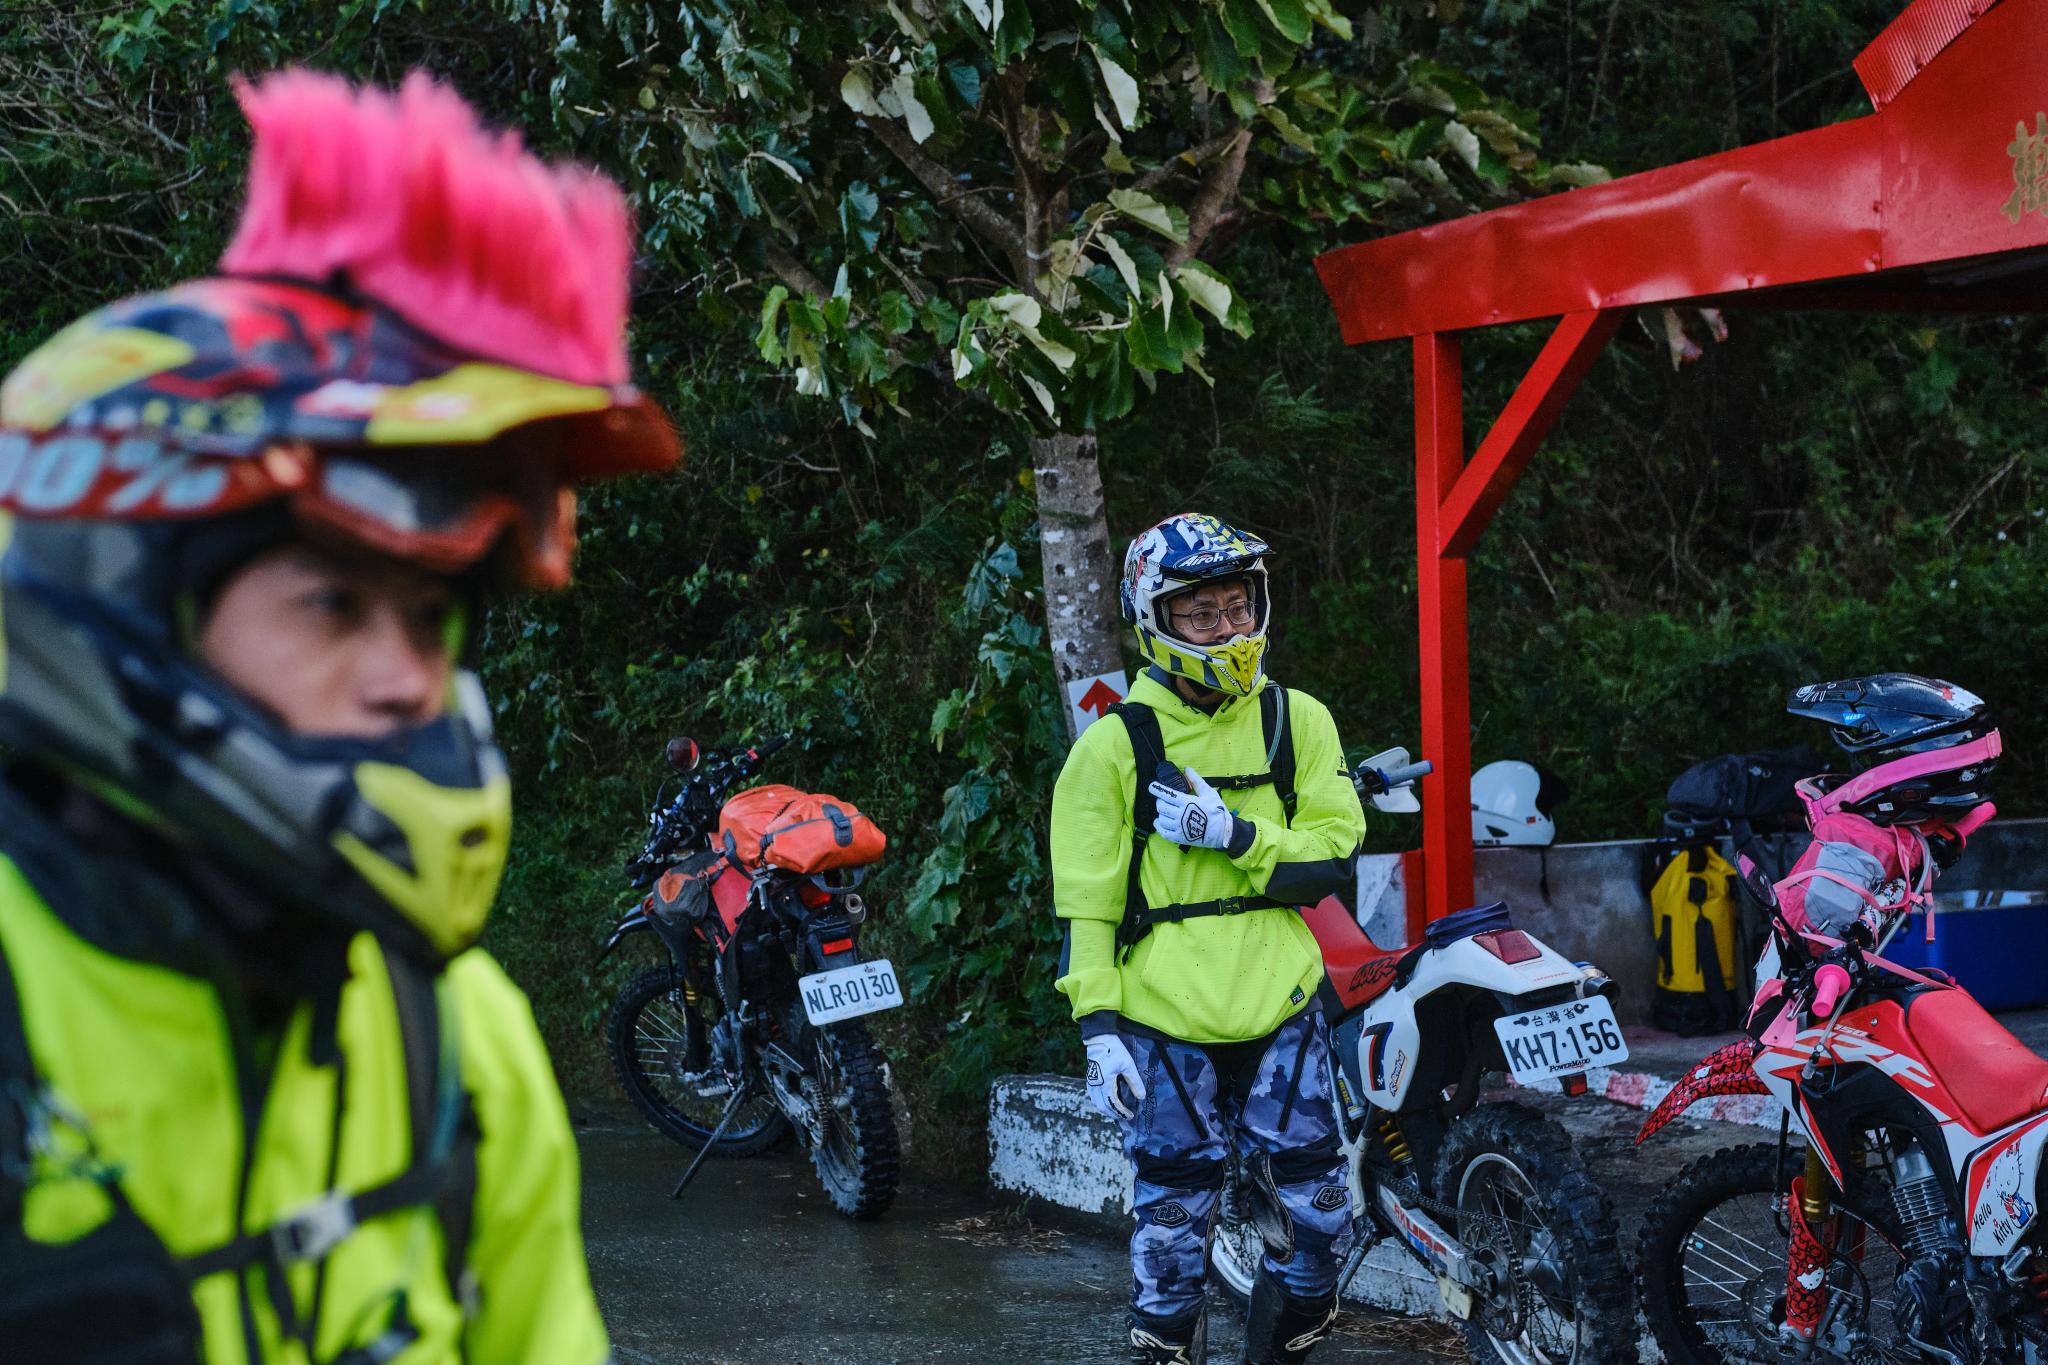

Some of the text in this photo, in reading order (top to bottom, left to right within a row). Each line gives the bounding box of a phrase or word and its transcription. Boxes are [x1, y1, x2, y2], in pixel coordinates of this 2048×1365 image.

[1179, 554, 1224, 569] Airoh
[1531, 1007, 1577, 1028] 台灣省
[1973, 1202, 1992, 1233] Hello
[1992, 1218, 2014, 1247] Kitty
